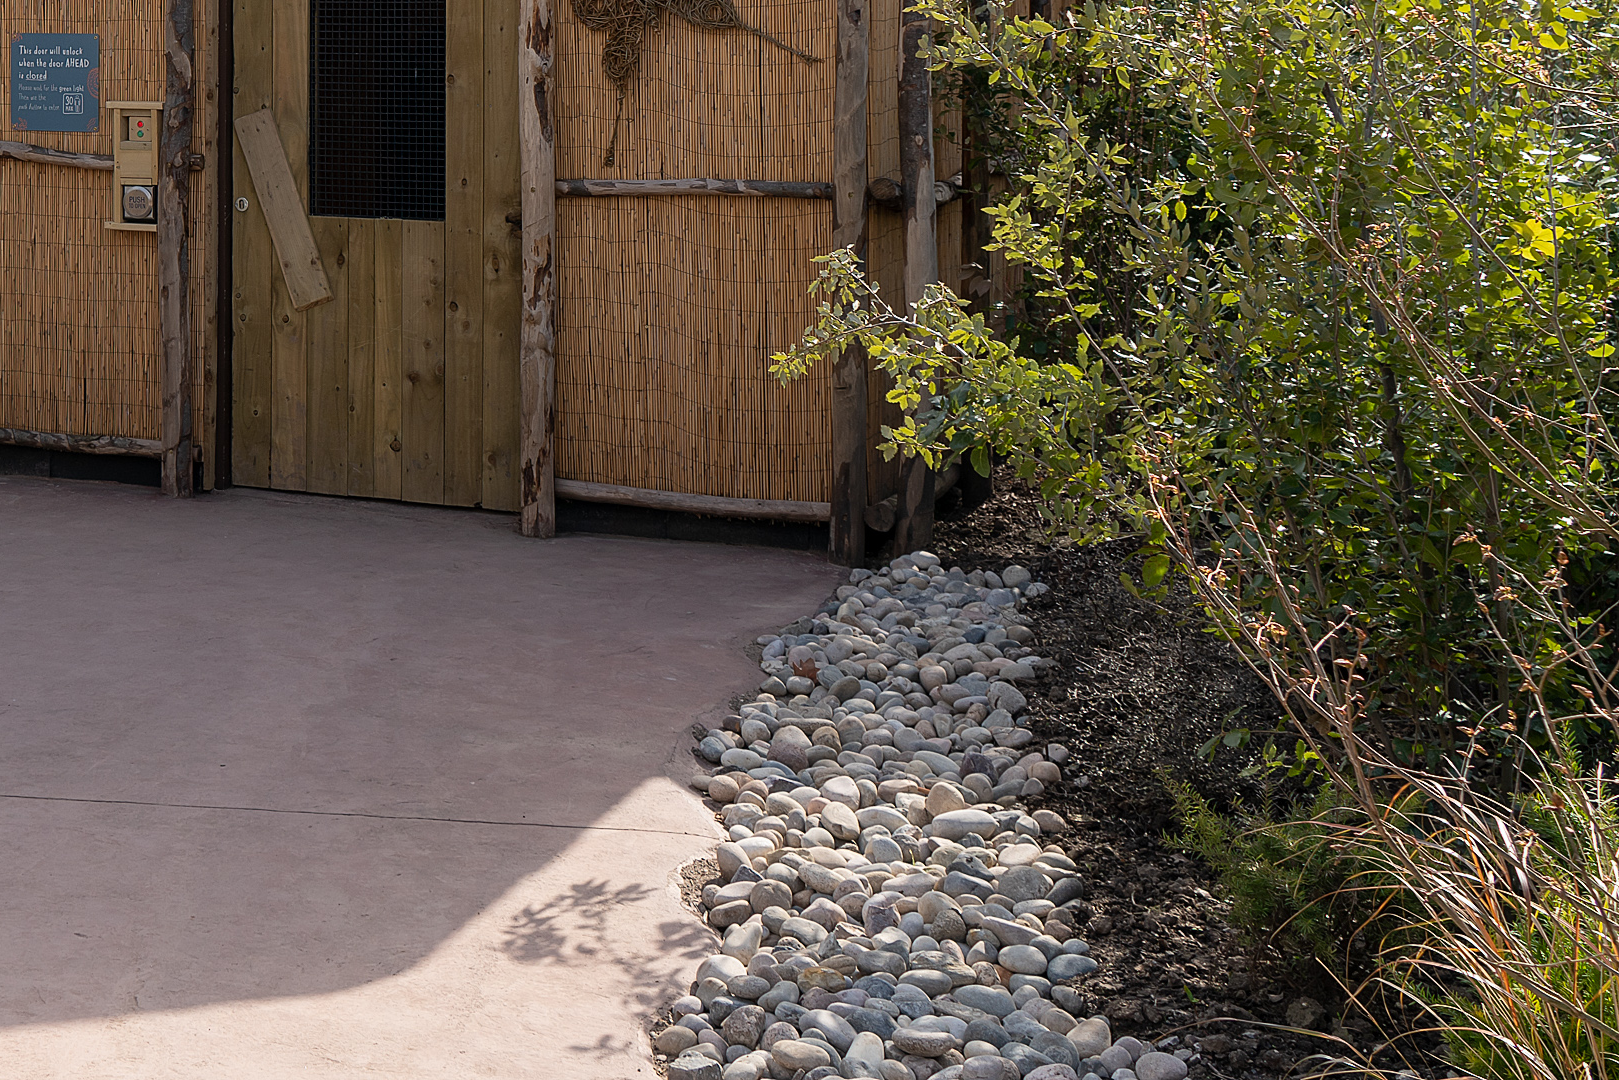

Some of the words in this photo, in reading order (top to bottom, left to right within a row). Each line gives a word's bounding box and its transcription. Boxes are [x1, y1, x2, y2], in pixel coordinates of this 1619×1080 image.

[19, 45, 32, 55] This
[34, 45, 48, 55] door
[50, 46, 61, 55] will
[63, 46, 83, 56] unlock
[18, 58, 35, 68] when
[37, 58, 47, 68] the
[49, 58, 64, 68] door
[65, 58, 90, 68] AHEAD
[18, 71, 24, 79] is
[26, 70, 47, 81] closed
[18, 83, 32, 91] Please
[18, 93, 29, 101] Then
[65, 96, 74, 106] 30
